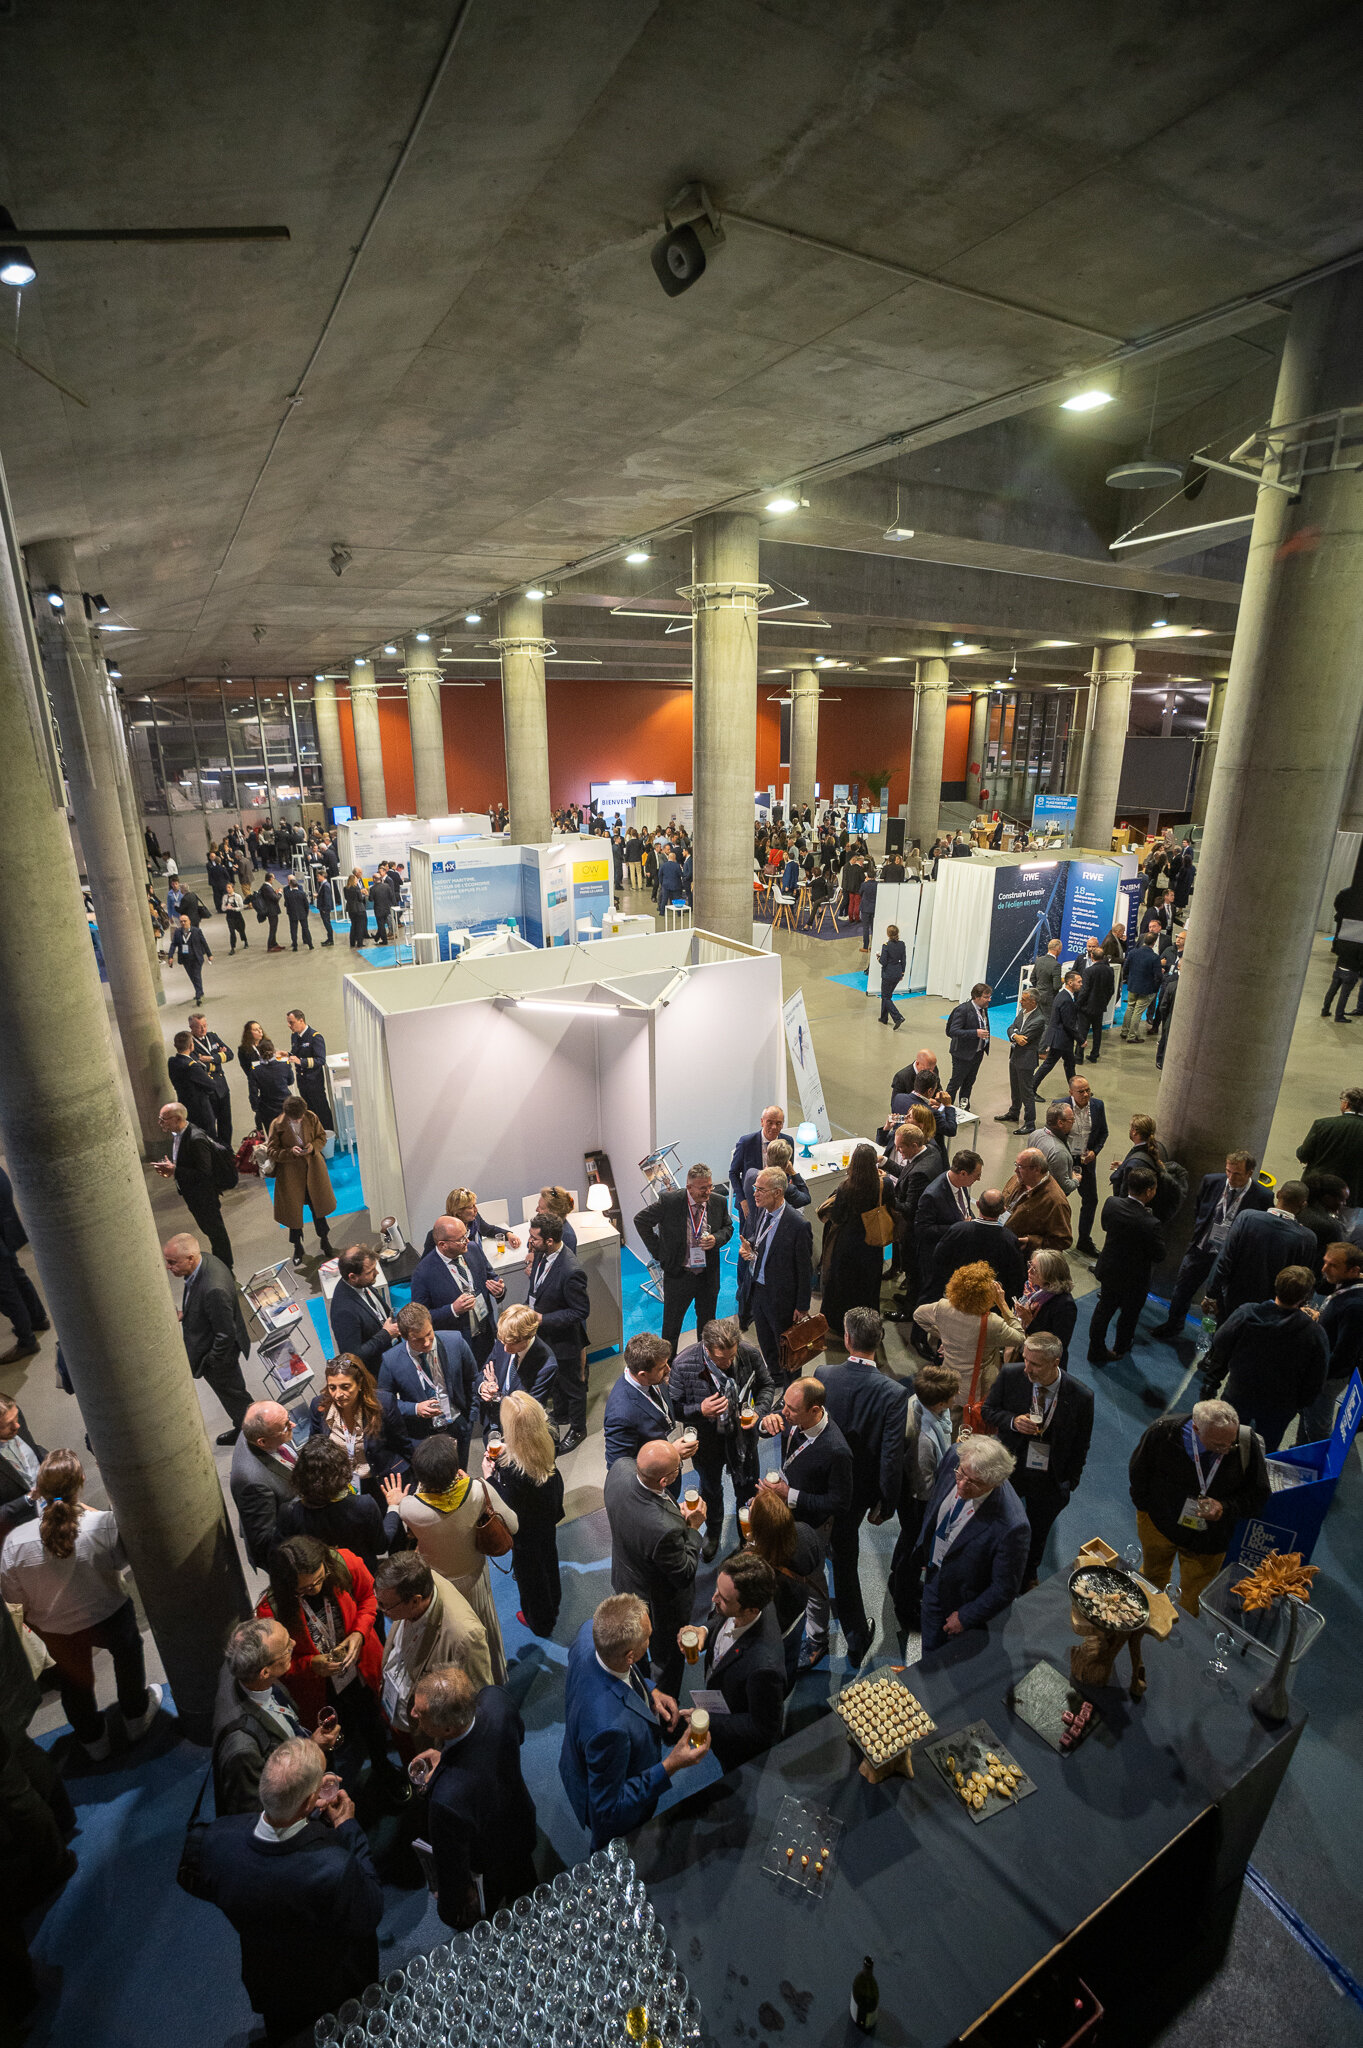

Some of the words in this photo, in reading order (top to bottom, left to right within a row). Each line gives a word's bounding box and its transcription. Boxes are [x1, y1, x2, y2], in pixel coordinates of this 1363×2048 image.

[1023, 873, 1040, 881] RWE
[1083, 872, 1104, 881] RWE
[999, 891, 1026, 900] Construire
[1027, 888, 1046, 897] l'avenir
[1075, 886, 1085, 894] 18
[1005, 900, 1023, 908] l'éolien
[1252, 1523, 1264, 1535] LA
[1249, 1535, 1264, 1545] DU
[1252, 1530, 1276, 1542] VOIX
[1247, 1541, 1272, 1554] NOR
